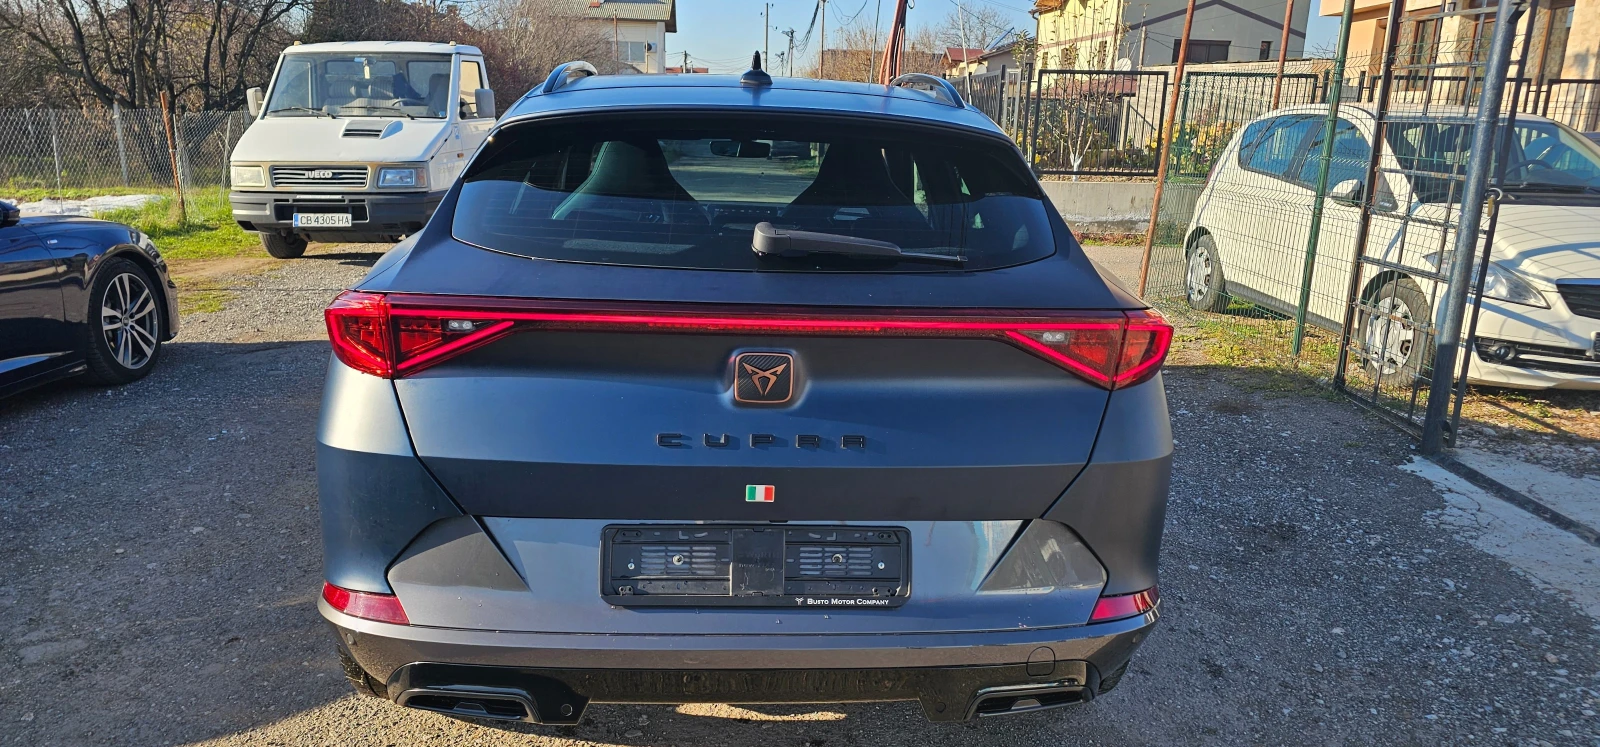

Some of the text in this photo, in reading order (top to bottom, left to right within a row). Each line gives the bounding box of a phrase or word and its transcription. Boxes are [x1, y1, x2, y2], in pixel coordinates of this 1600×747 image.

[304, 170, 332, 178] IVECO
[300, 215, 350, 225] CB 4305 HA
[656, 433, 868, 449] CUPRA
